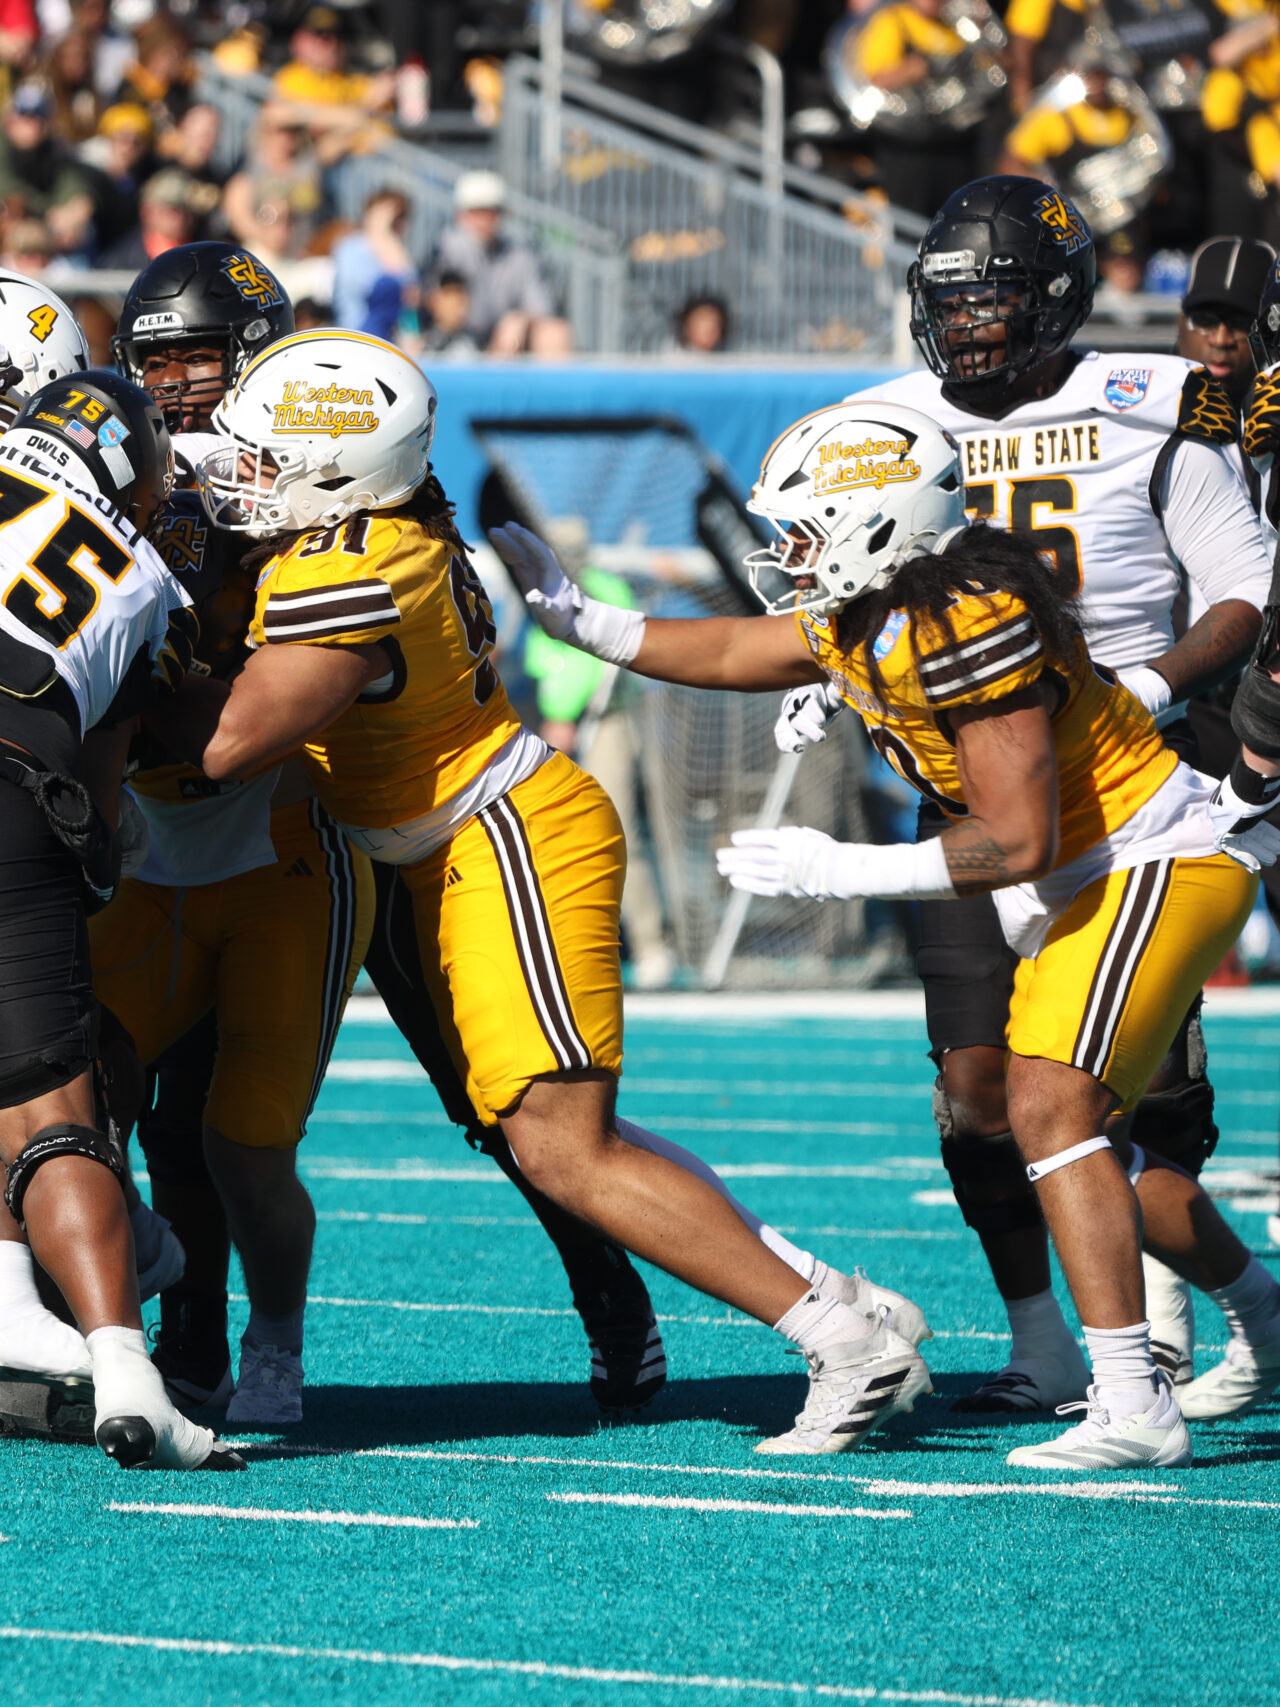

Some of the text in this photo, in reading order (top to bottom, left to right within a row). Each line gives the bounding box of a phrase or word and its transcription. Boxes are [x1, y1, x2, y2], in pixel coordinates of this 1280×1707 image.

[26, 303, 60, 344] 4
[138, 314, 176, 328] H.E.T.M.
[59, 389, 109, 424] 75
[283, 381, 374, 406] Western
[272, 404, 379, 438] Michigan
[26, 434, 70, 467] OWLS
[818, 437, 911, 465] Western
[960, 424, 1101, 477] ESAW STATE
[812, 459, 921, 497] Michigan
[964, 474, 1085, 598] 6
[23, 1137, 75, 1159] DONJOY
